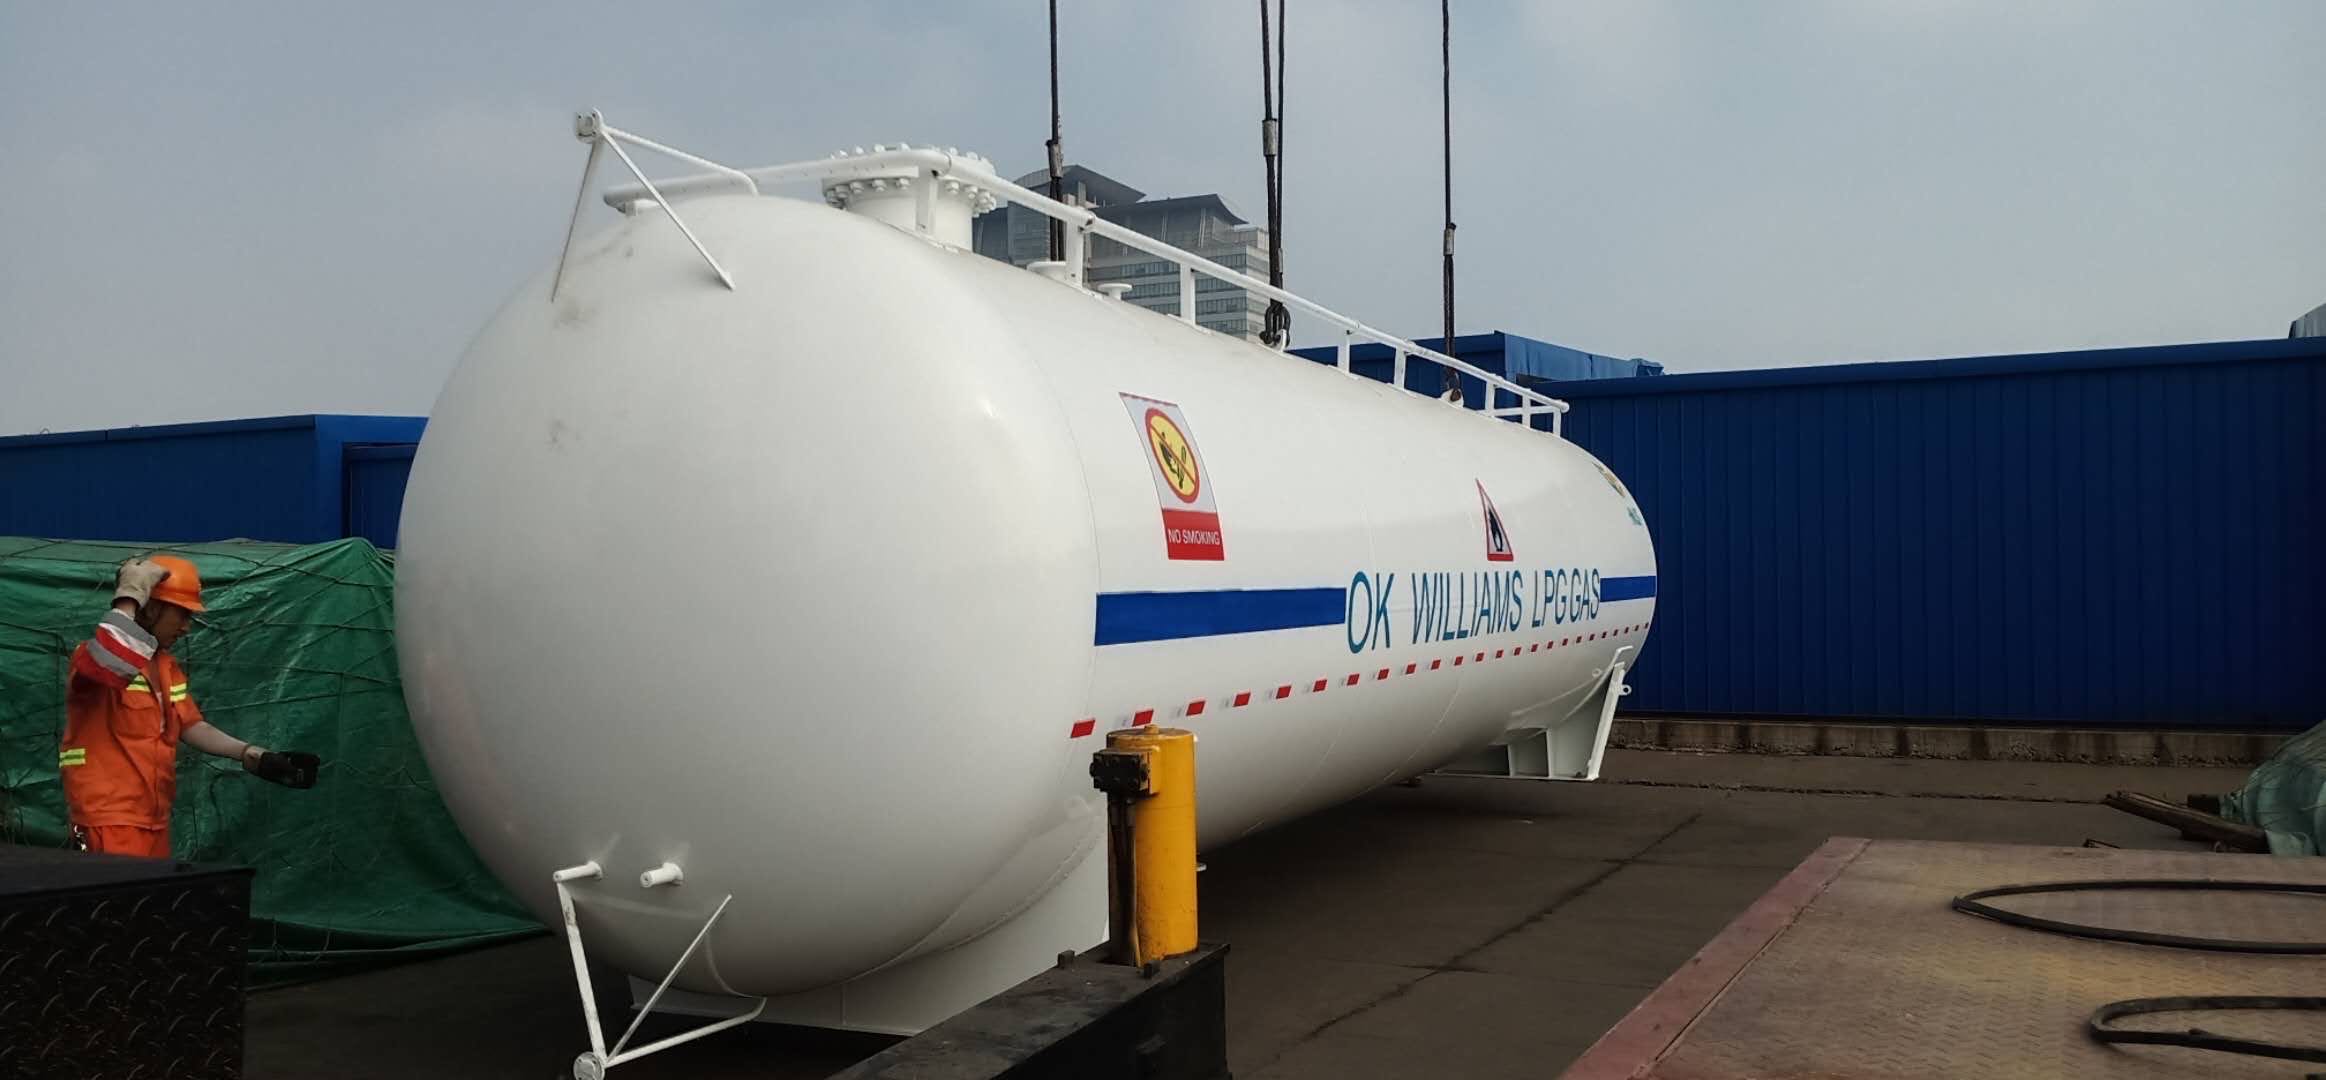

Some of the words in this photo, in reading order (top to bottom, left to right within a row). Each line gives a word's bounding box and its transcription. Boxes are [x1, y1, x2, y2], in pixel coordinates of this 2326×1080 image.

[1167, 528, 1181, 543] NO
[1182, 529, 1220, 545] SMOKING
[1347, 570, 1395, 654] OK
[1411, 569, 1524, 645] WILLIAMS
